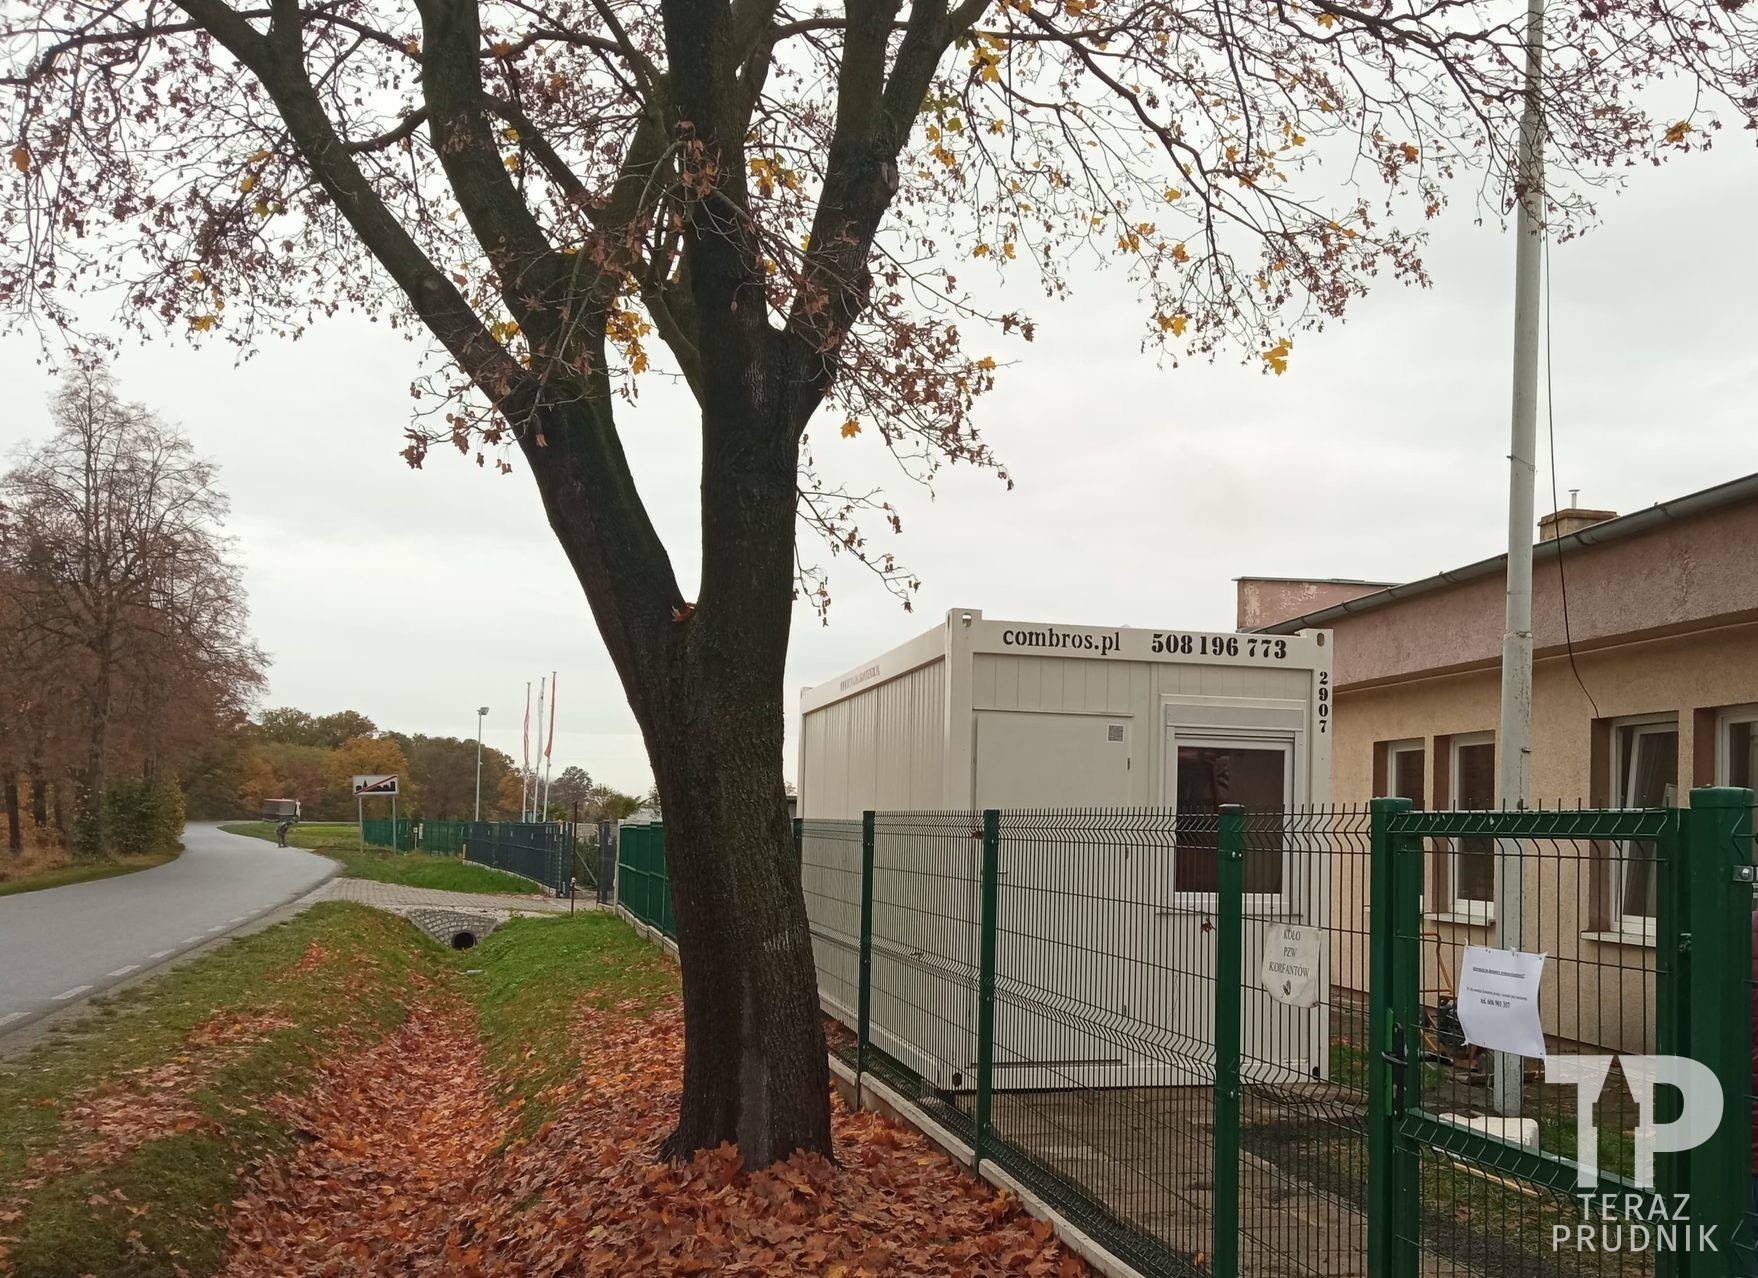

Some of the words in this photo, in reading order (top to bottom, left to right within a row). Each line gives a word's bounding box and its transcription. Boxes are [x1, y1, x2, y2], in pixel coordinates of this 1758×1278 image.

[1002, 627, 1121, 656] combros.pl
[1151, 633, 1193, 655] 508
[1199, 634, 1239, 657] 196
[1247, 637, 1287, 660] 773
[1318, 671, 1329, 733] 2907
